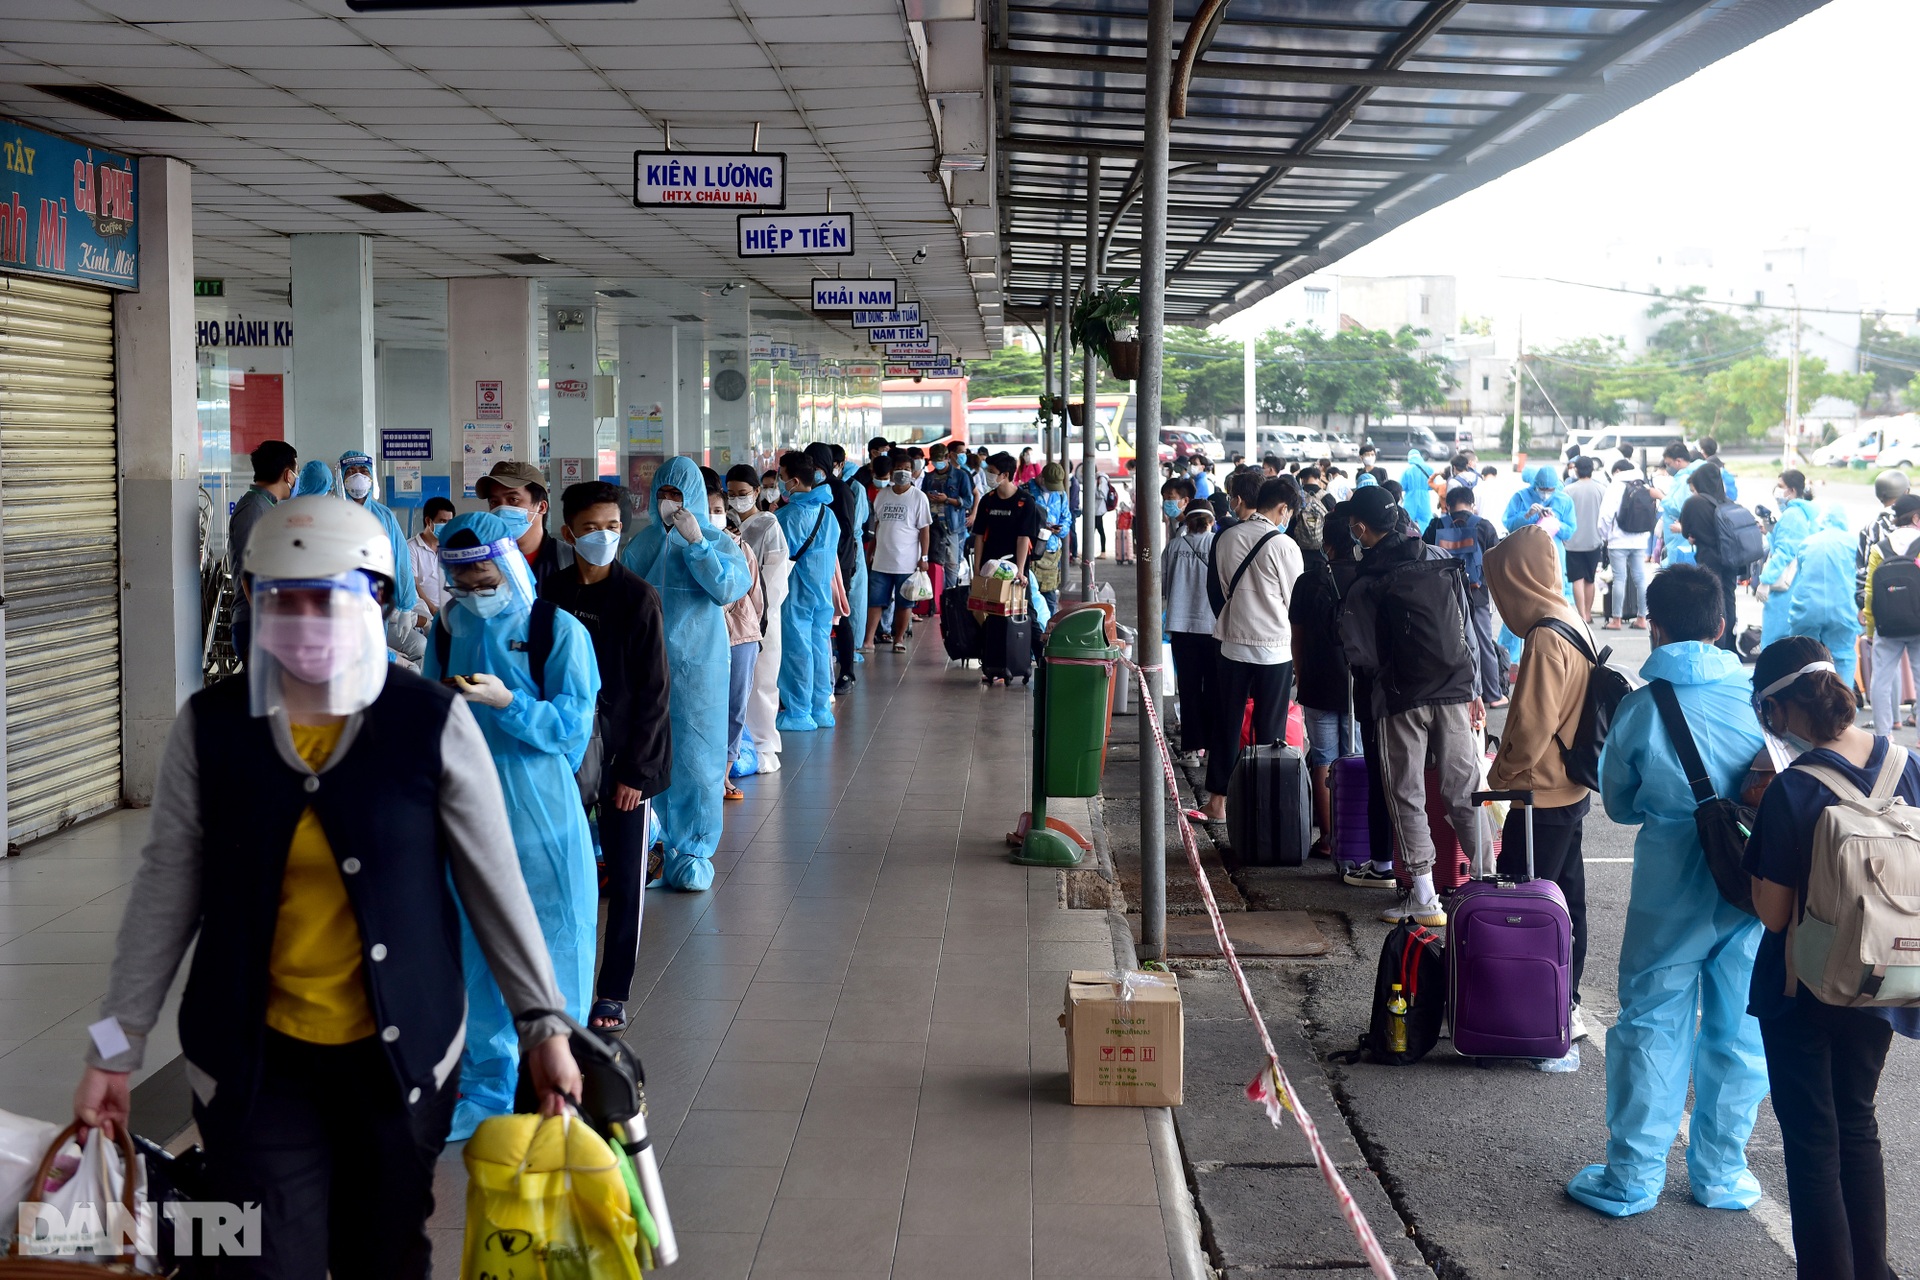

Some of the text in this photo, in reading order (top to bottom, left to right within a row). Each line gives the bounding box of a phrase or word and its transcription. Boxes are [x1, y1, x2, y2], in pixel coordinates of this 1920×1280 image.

[3, 137, 36, 176] TÂY
[74, 148, 133, 222] CÀ PHÊ
[647, 160, 773, 188] KIÊN LƯƠNG
[662, 189, 757, 203] (HTX CHÂU HÀ)
[36, 196, 67, 271] Mì
[100, 221, 123, 234] Coffee
[746, 220, 846, 253] HIỆP TIẾN
[817, 286, 892, 305] KHẢI NAM
[195, 320, 220, 346] HO
[225, 313, 268, 346] HÀNH
[872, 328, 895, 340] NAM
[461, 547, 487, 557] Shield
